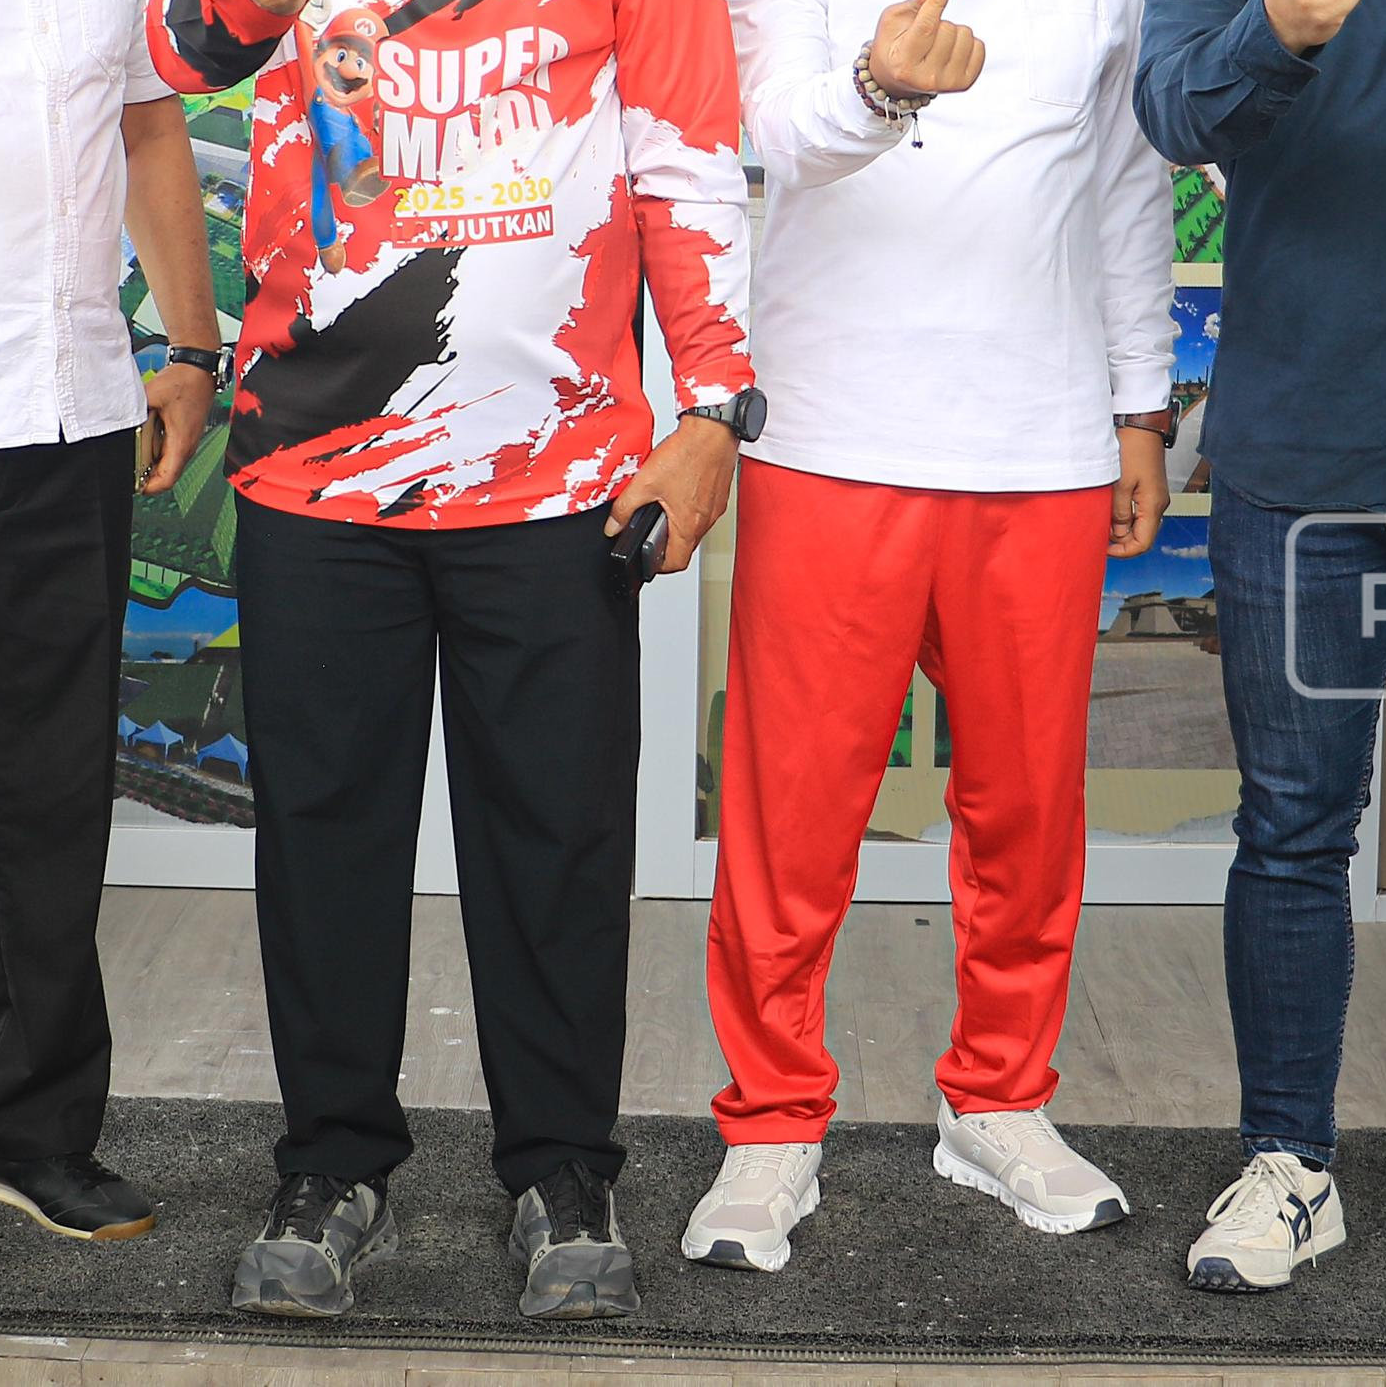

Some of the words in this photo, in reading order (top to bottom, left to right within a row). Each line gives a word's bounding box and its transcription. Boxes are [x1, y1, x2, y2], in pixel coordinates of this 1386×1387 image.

[393, 187, 465, 212] 2025
[491, 177, 552, 206] 2030
[396, 210, 551, 244] ANJUTKAN
